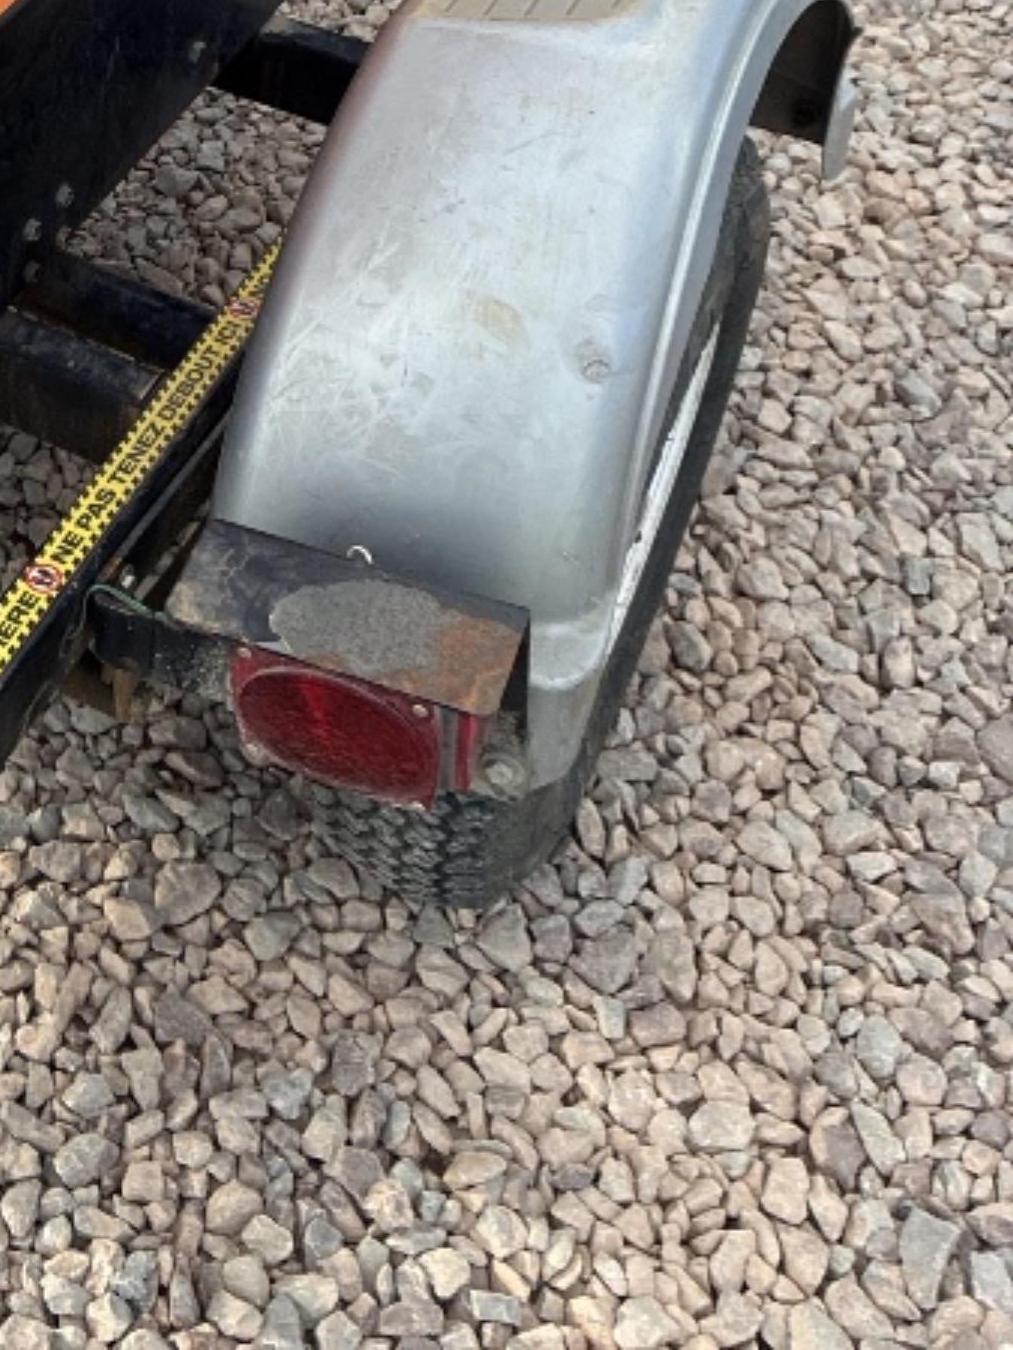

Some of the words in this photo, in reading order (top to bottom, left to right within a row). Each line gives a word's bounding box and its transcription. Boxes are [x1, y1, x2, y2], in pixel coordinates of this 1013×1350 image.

[49, 530, 84, 564] NE
[76, 488, 117, 529] PAS
[110, 422, 164, 484] TENEZ
[158, 345, 220, 422] DEBOUT
